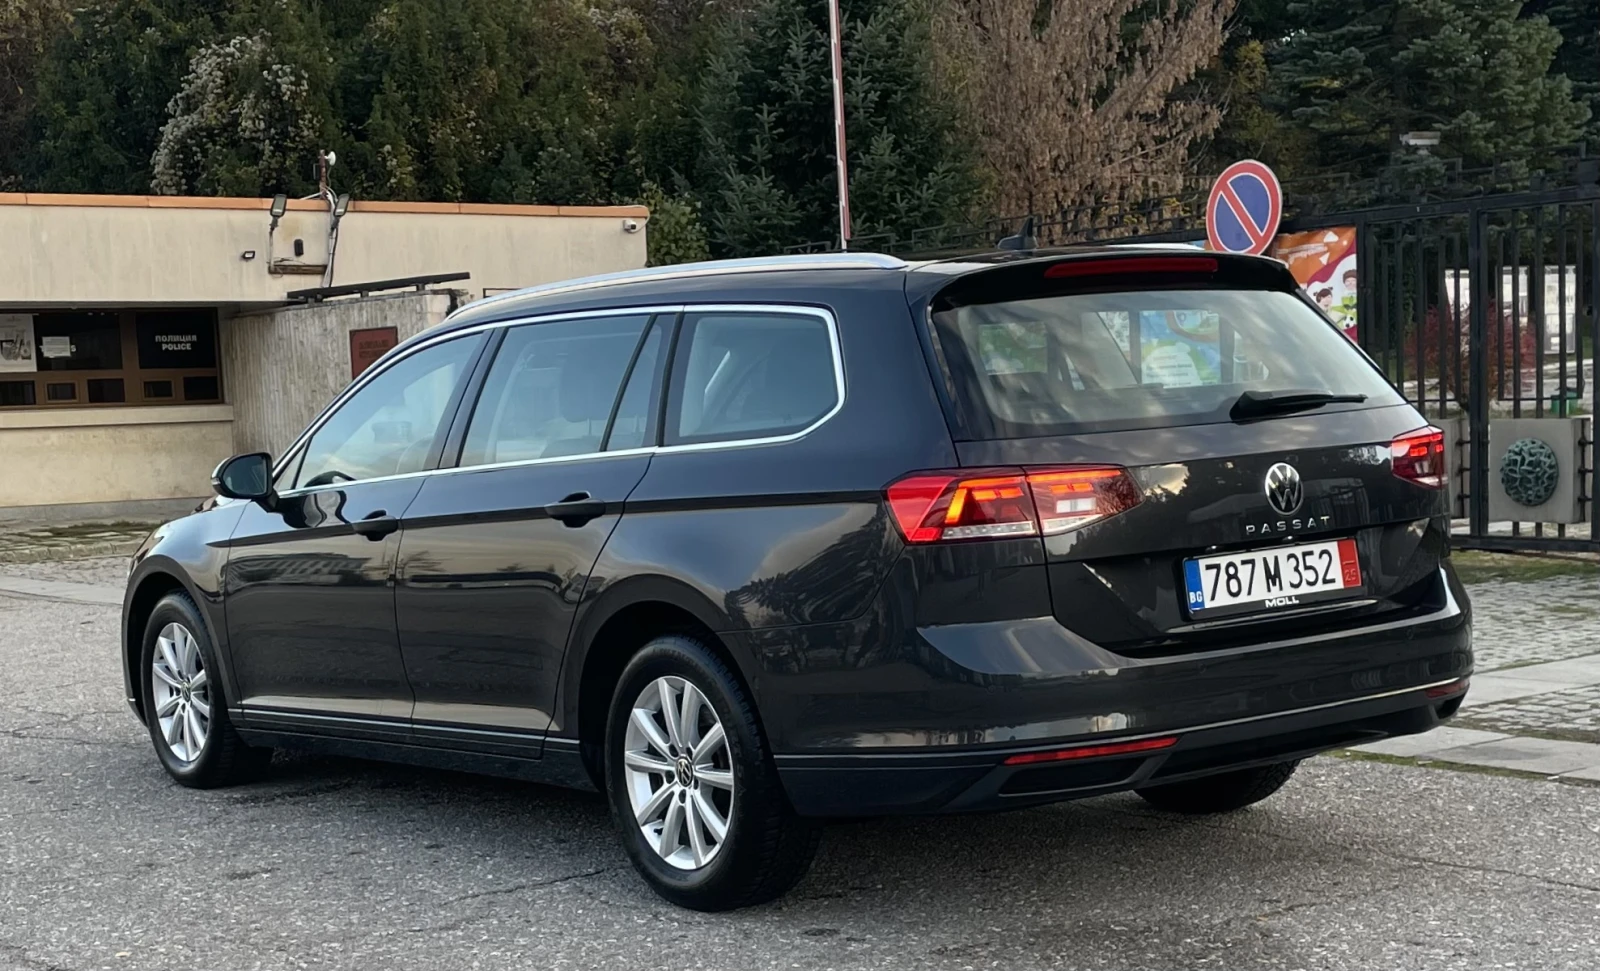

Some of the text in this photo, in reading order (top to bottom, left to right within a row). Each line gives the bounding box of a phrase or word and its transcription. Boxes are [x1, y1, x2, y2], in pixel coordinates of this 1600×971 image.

[155, 334, 197, 342] ПОЛИЦИЯ
[1246, 516, 1330, 535] PASSAT
[1205, 549, 1336, 601] 787 M 352
[1189, 591, 1203, 604] BG
[1264, 596, 1299, 608] MOLL
